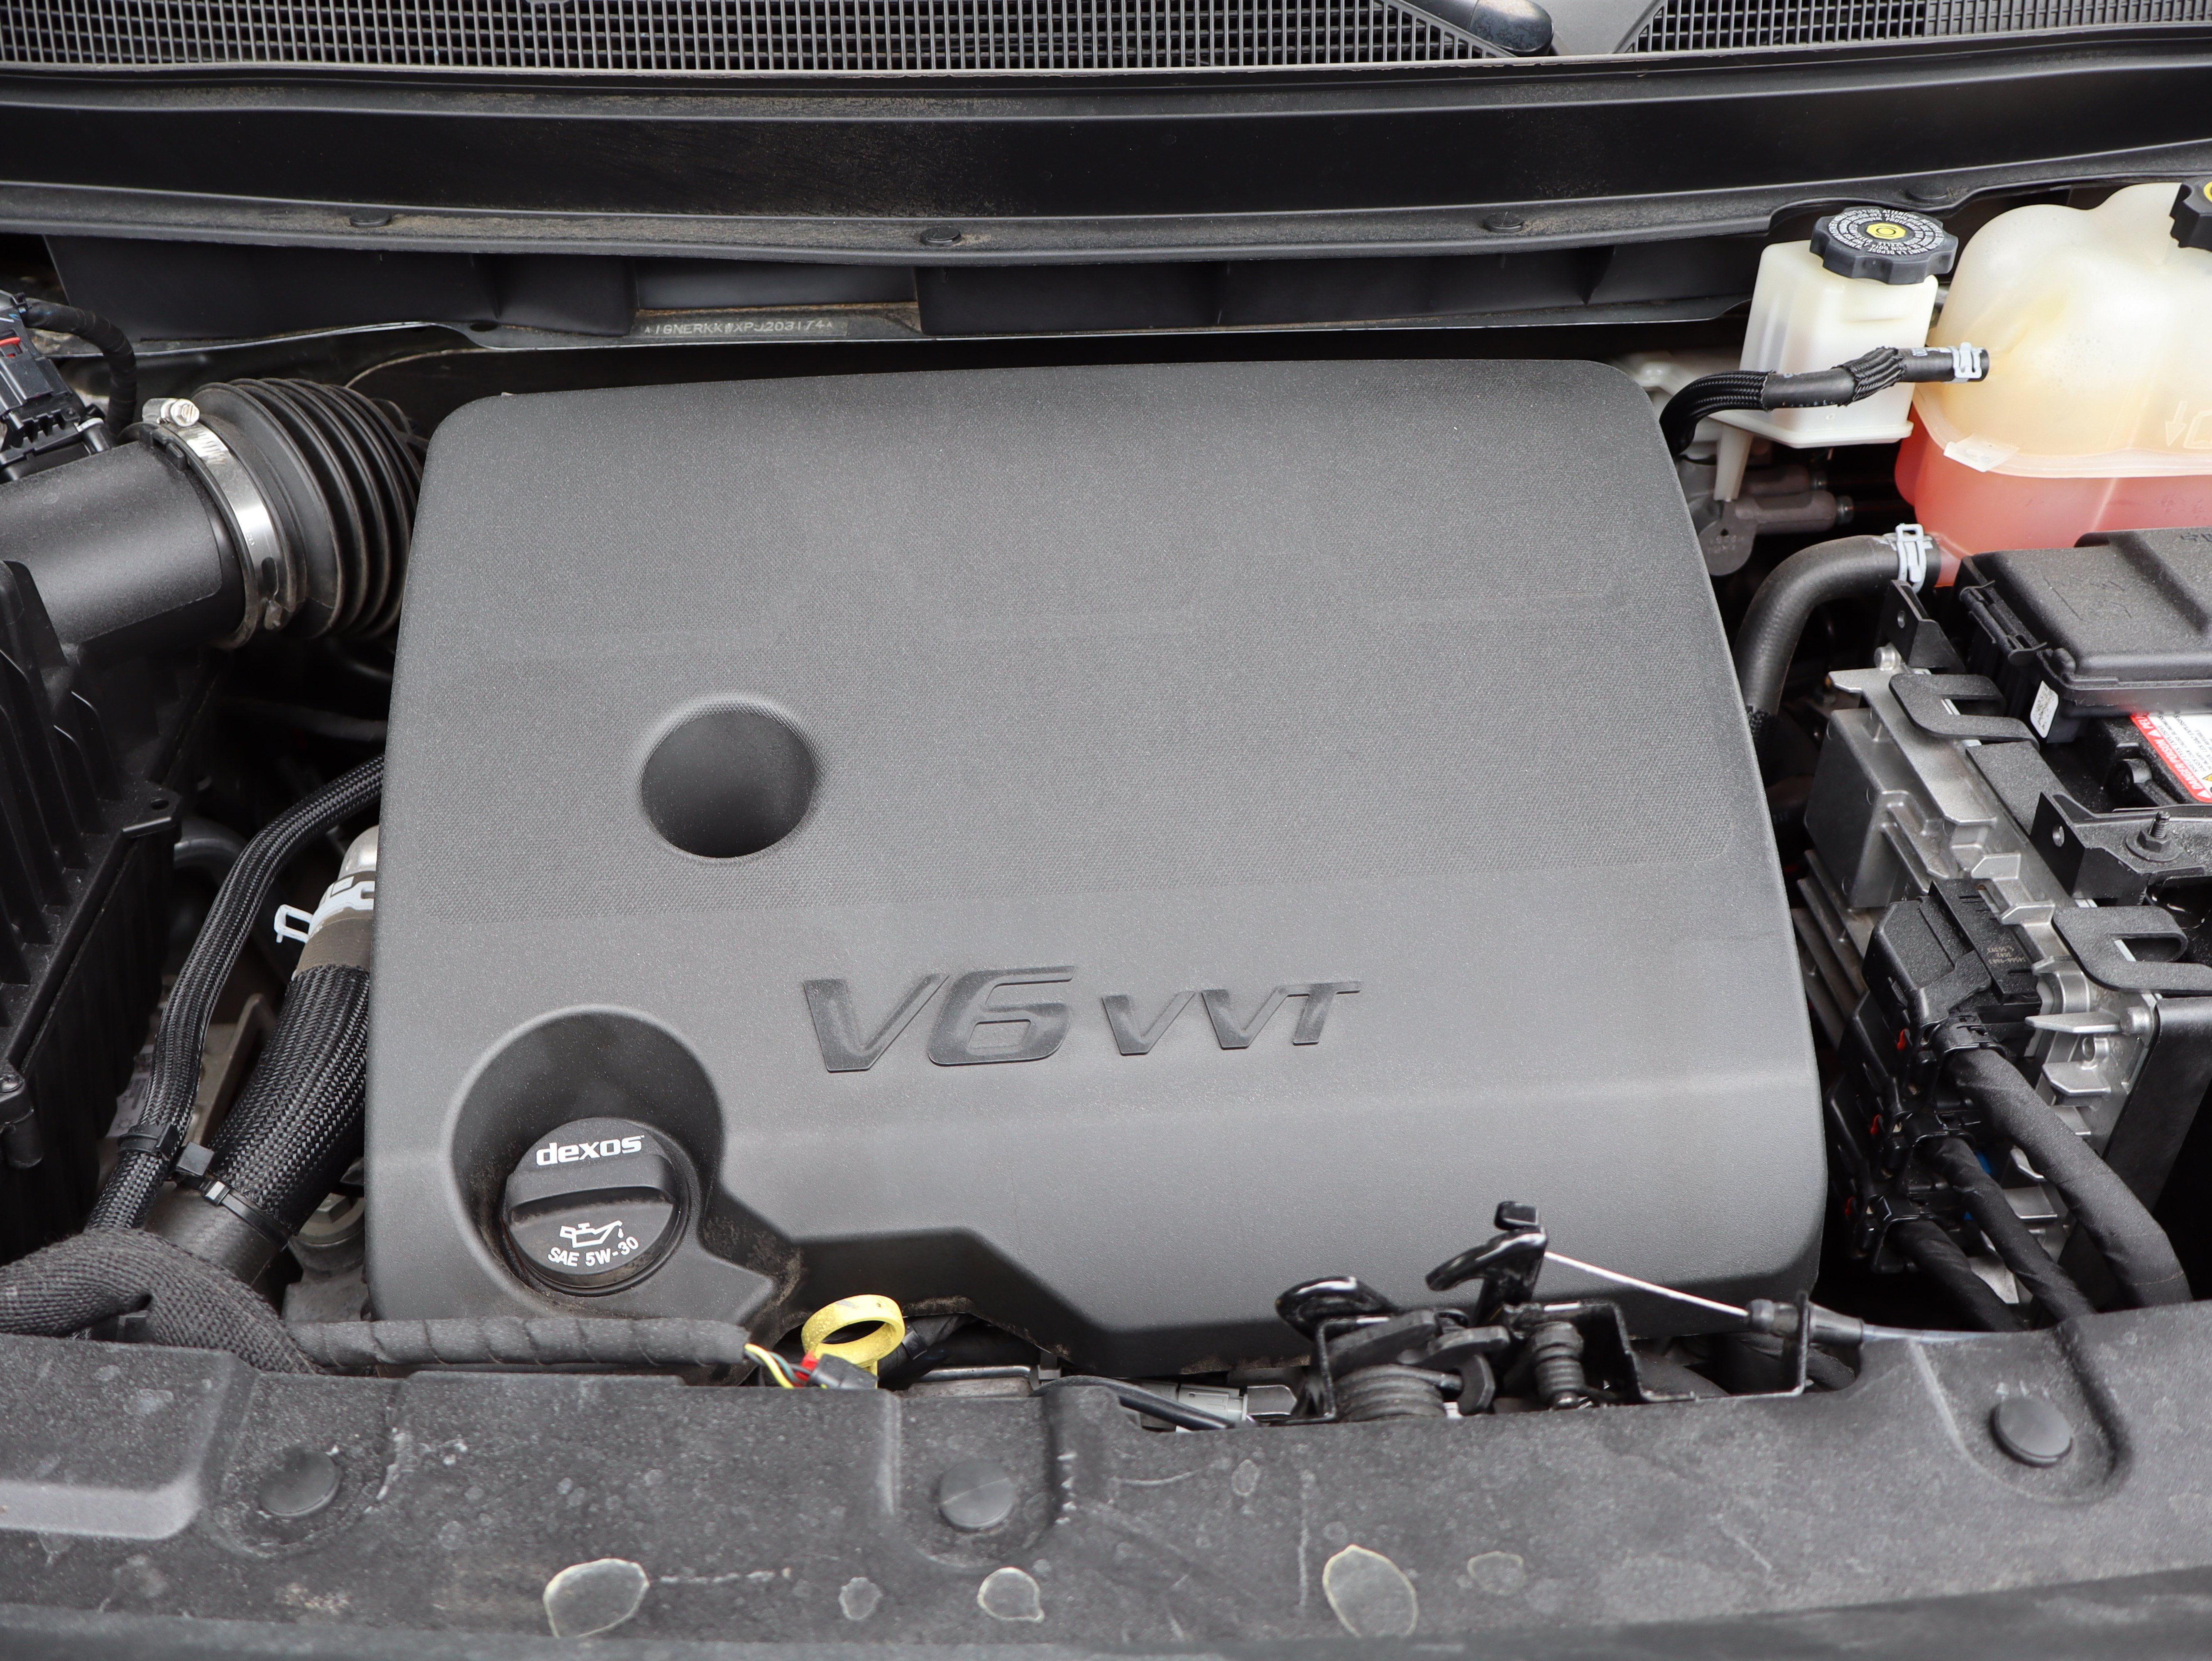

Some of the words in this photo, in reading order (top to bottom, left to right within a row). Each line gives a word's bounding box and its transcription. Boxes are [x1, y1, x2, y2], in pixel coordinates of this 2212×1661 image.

[803, 965, 1074, 1073] V6
[1101, 980, 1363, 1056] VVT
[548, 1247, 580, 1267] SAE
[585, 1236, 639, 1266] 5W-30
